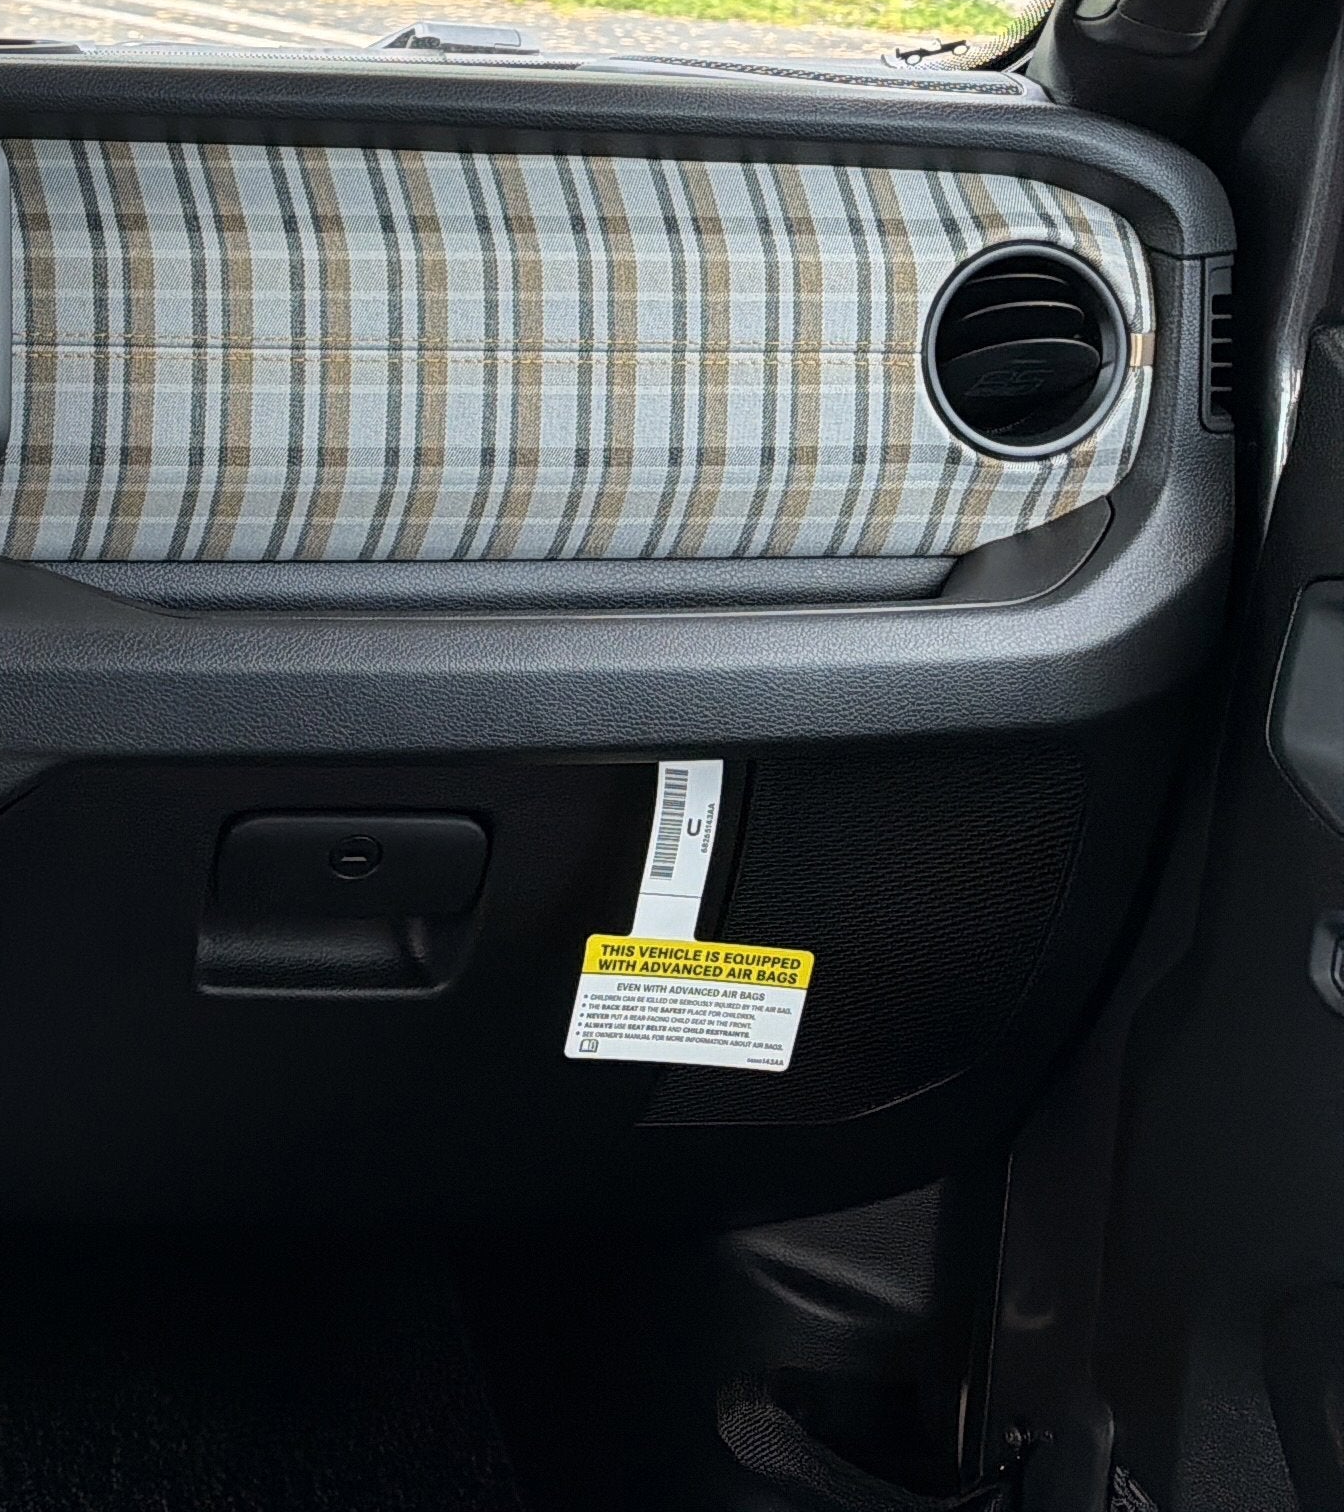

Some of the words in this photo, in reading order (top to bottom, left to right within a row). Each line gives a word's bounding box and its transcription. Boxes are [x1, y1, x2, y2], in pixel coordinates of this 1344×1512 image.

[602, 944, 635, 958] THIS
[639, 946, 701, 962] VEHICLE
[705, 951, 720, 963] IS
[723, 953, 801, 971] EQUIPPED
[599, 959, 636, 972] WITH
[639, 962, 723, 978] ADVANCED
[727, 967, 752, 980] AIR
[756, 970, 798, 985] BAGS
[617, 982, 640, 992] EVEN
[644, 984, 666, 994] WITH
[669, 985, 719, 997] ADVANCED
[722, 989, 738, 999] AIR
[740, 990, 765, 1001] BAGS
